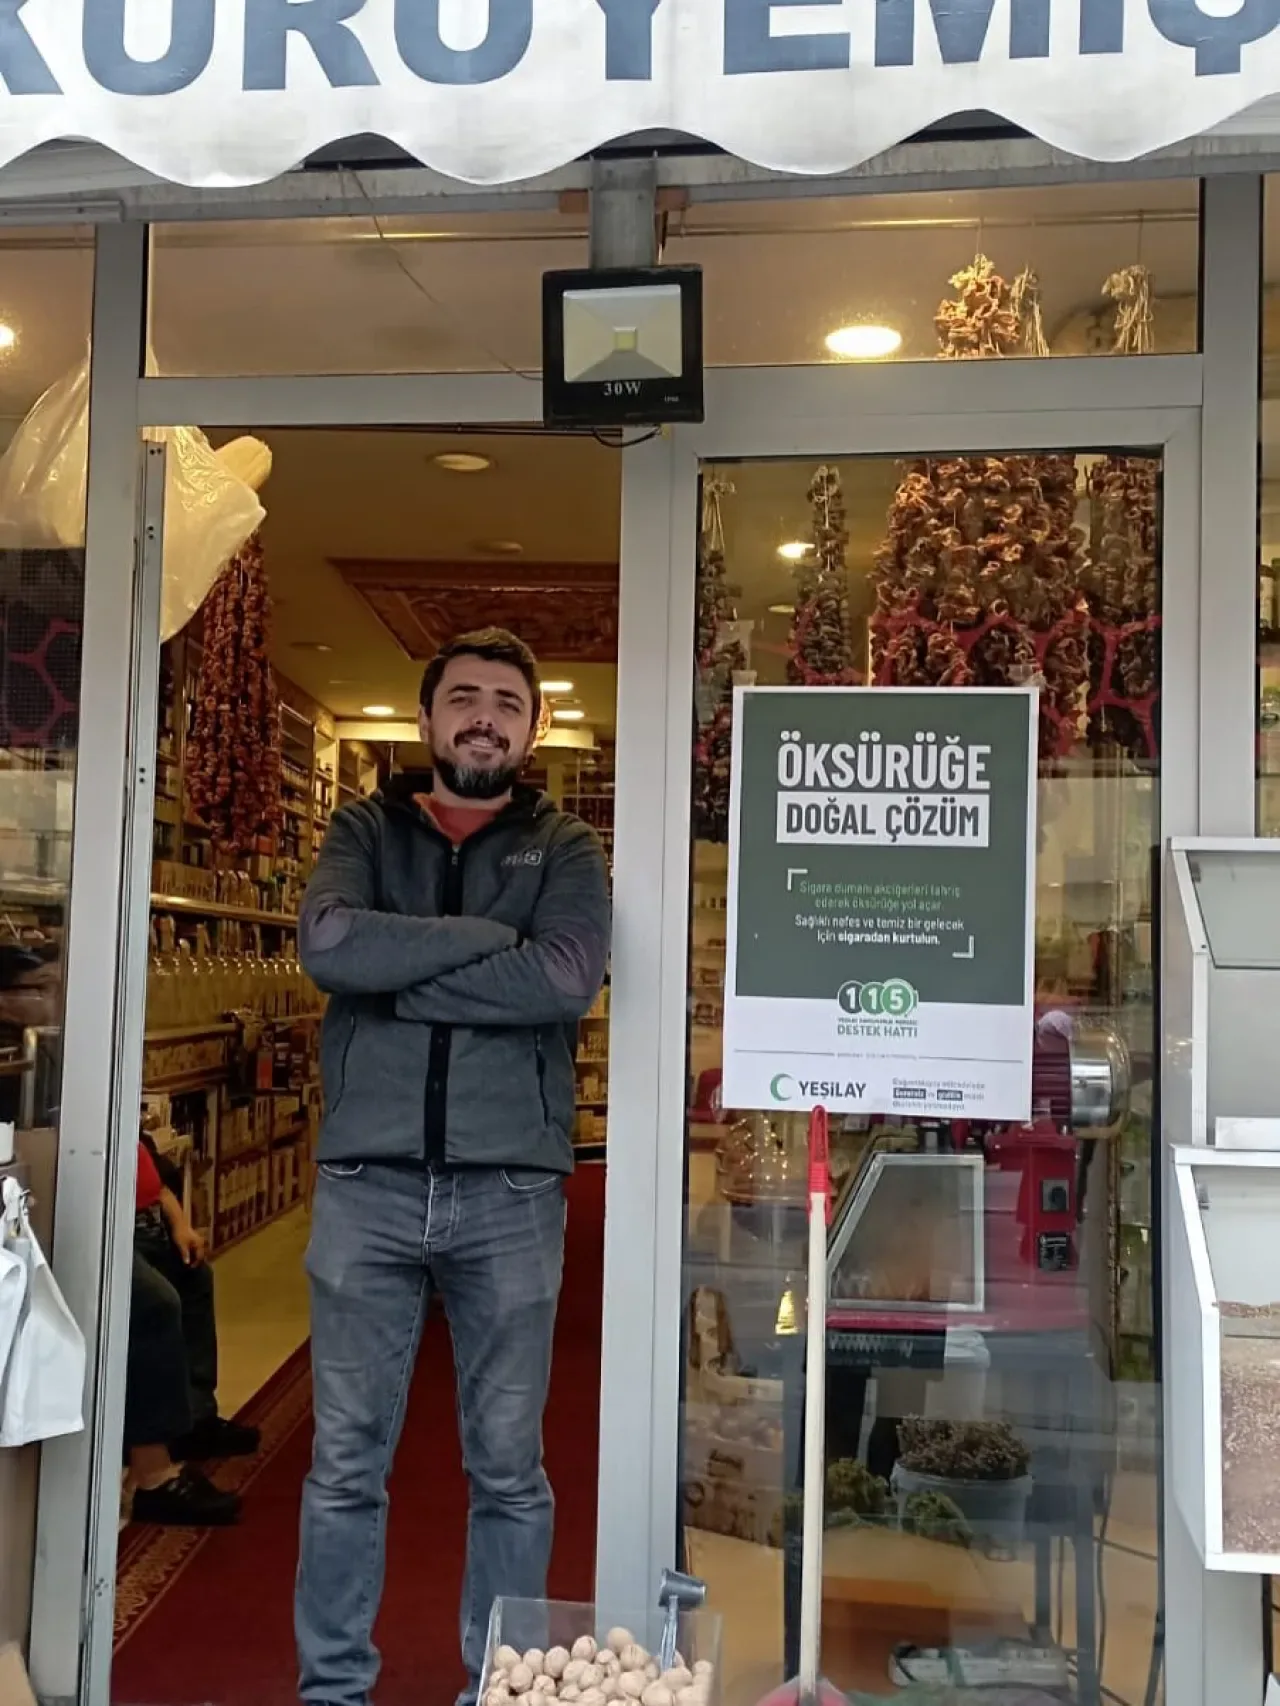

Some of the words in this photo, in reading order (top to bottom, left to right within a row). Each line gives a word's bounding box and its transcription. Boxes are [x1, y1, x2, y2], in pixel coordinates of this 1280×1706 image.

[604, 381, 642, 396] 30W
[778, 731, 991, 790] ÖKSÜRÜĞE
[786, 797, 876, 834] DOĞAL
[885, 796, 979, 843] ÇÖZÜM
[800, 881, 832, 896] Sigara
[901, 898, 917, 913] yol
[833, 916, 861, 928] nefes
[863, 918, 874, 928] ve
[876, 917, 905, 929] temiz
[907, 917, 921, 930] bir
[923, 918, 964, 932] gelecek
[838, 930, 890, 945] sigaradan
[843, 984, 908, 1014] 115
[837, 1024, 880, 1036] DESTEK
[884, 1025, 917, 1037] HATTI
